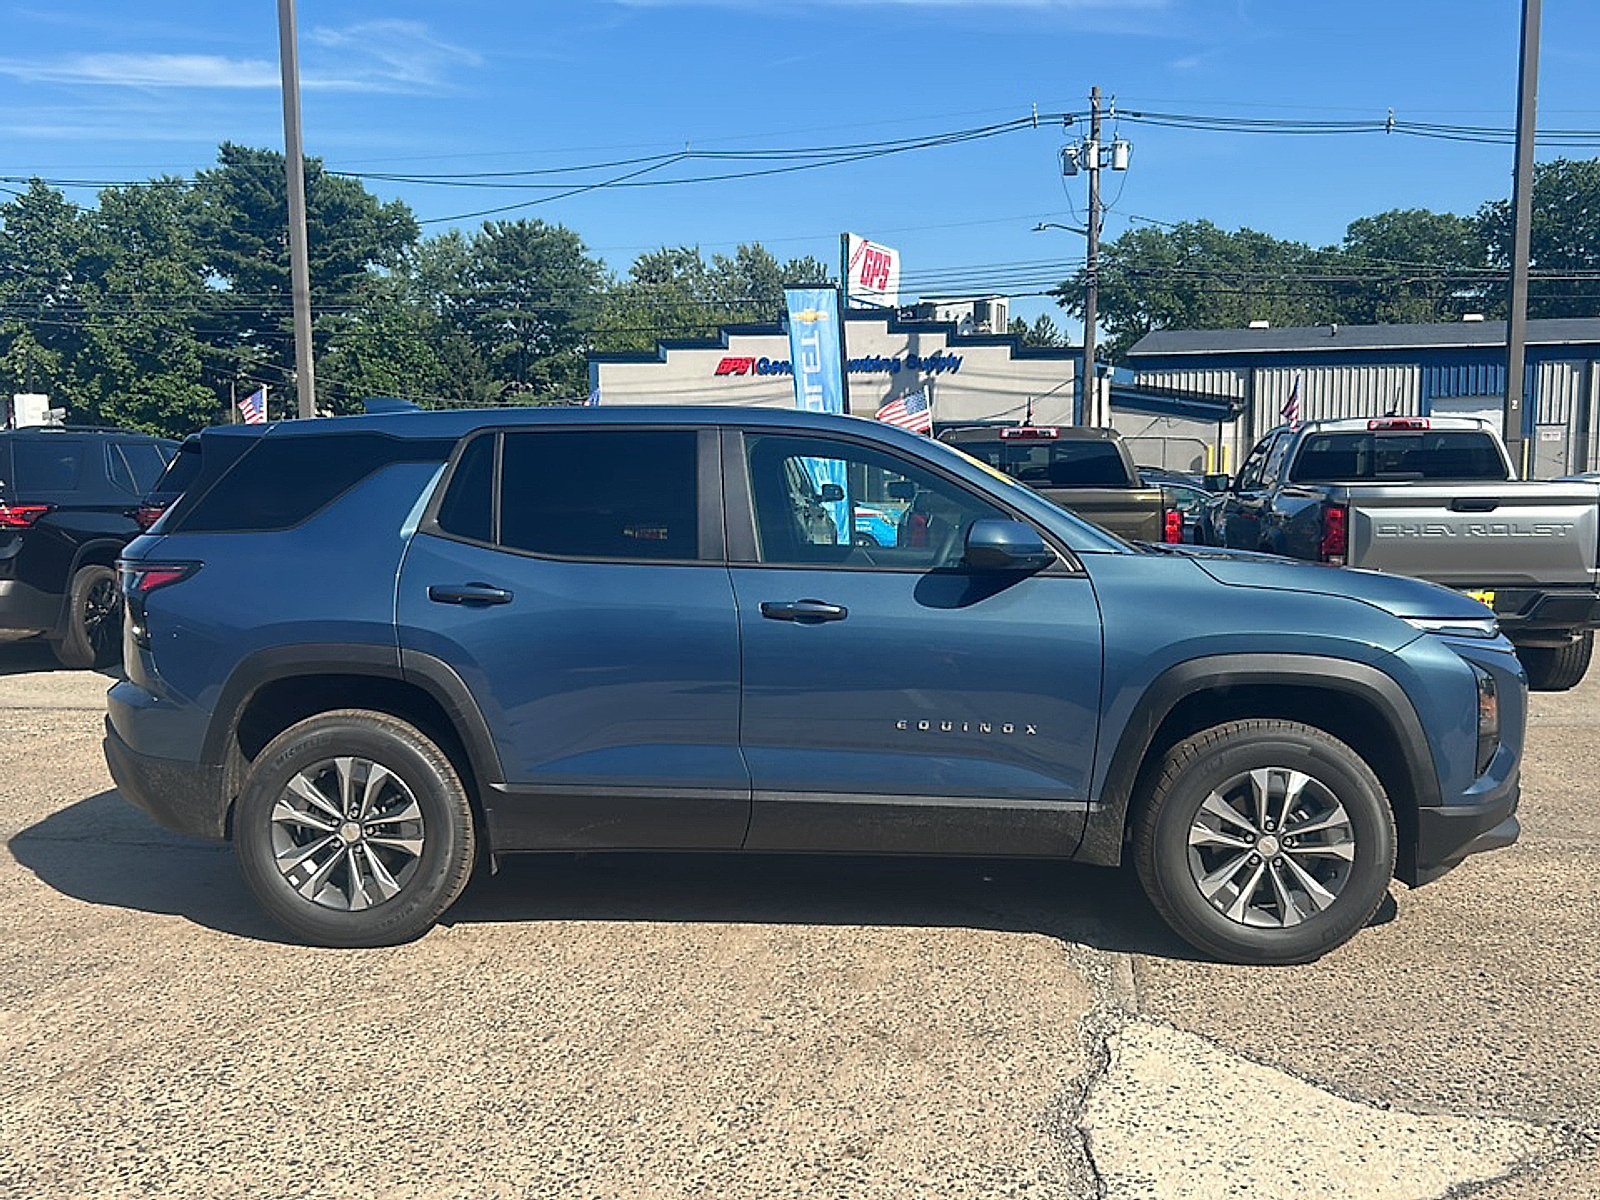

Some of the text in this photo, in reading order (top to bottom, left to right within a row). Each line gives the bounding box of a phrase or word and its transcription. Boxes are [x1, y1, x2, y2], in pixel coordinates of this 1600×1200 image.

[860, 248, 891, 291] GPS
[714, 356, 752, 376] GPS
[906, 352, 964, 375] Supply
[1511, 399, 1519, 410] 2
[1376, 523, 1574, 537] CHEVROLET
[896, 719, 1038, 735] EQUINOX
